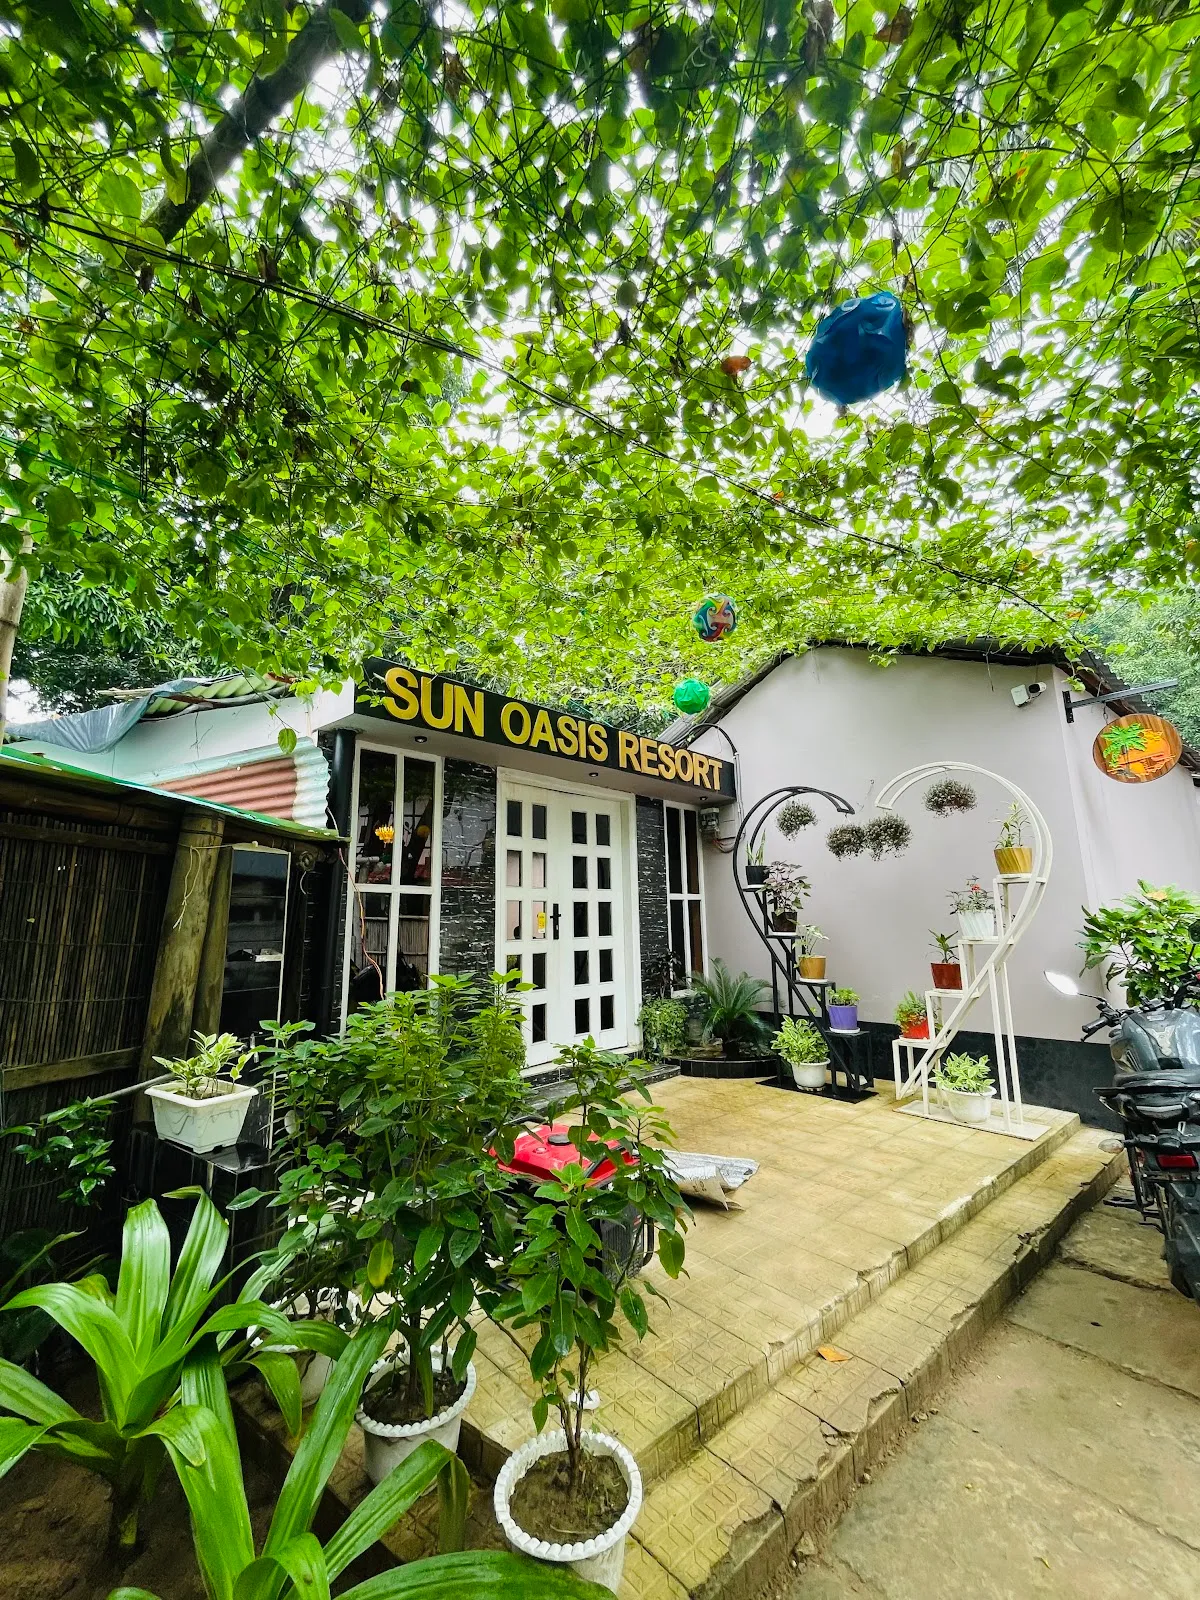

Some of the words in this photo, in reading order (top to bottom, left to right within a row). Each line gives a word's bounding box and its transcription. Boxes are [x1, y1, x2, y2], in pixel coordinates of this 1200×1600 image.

[384, 667, 485, 737] SUN
[500, 702, 609, 762] OASIS
[618, 730, 723, 791] RESORT
